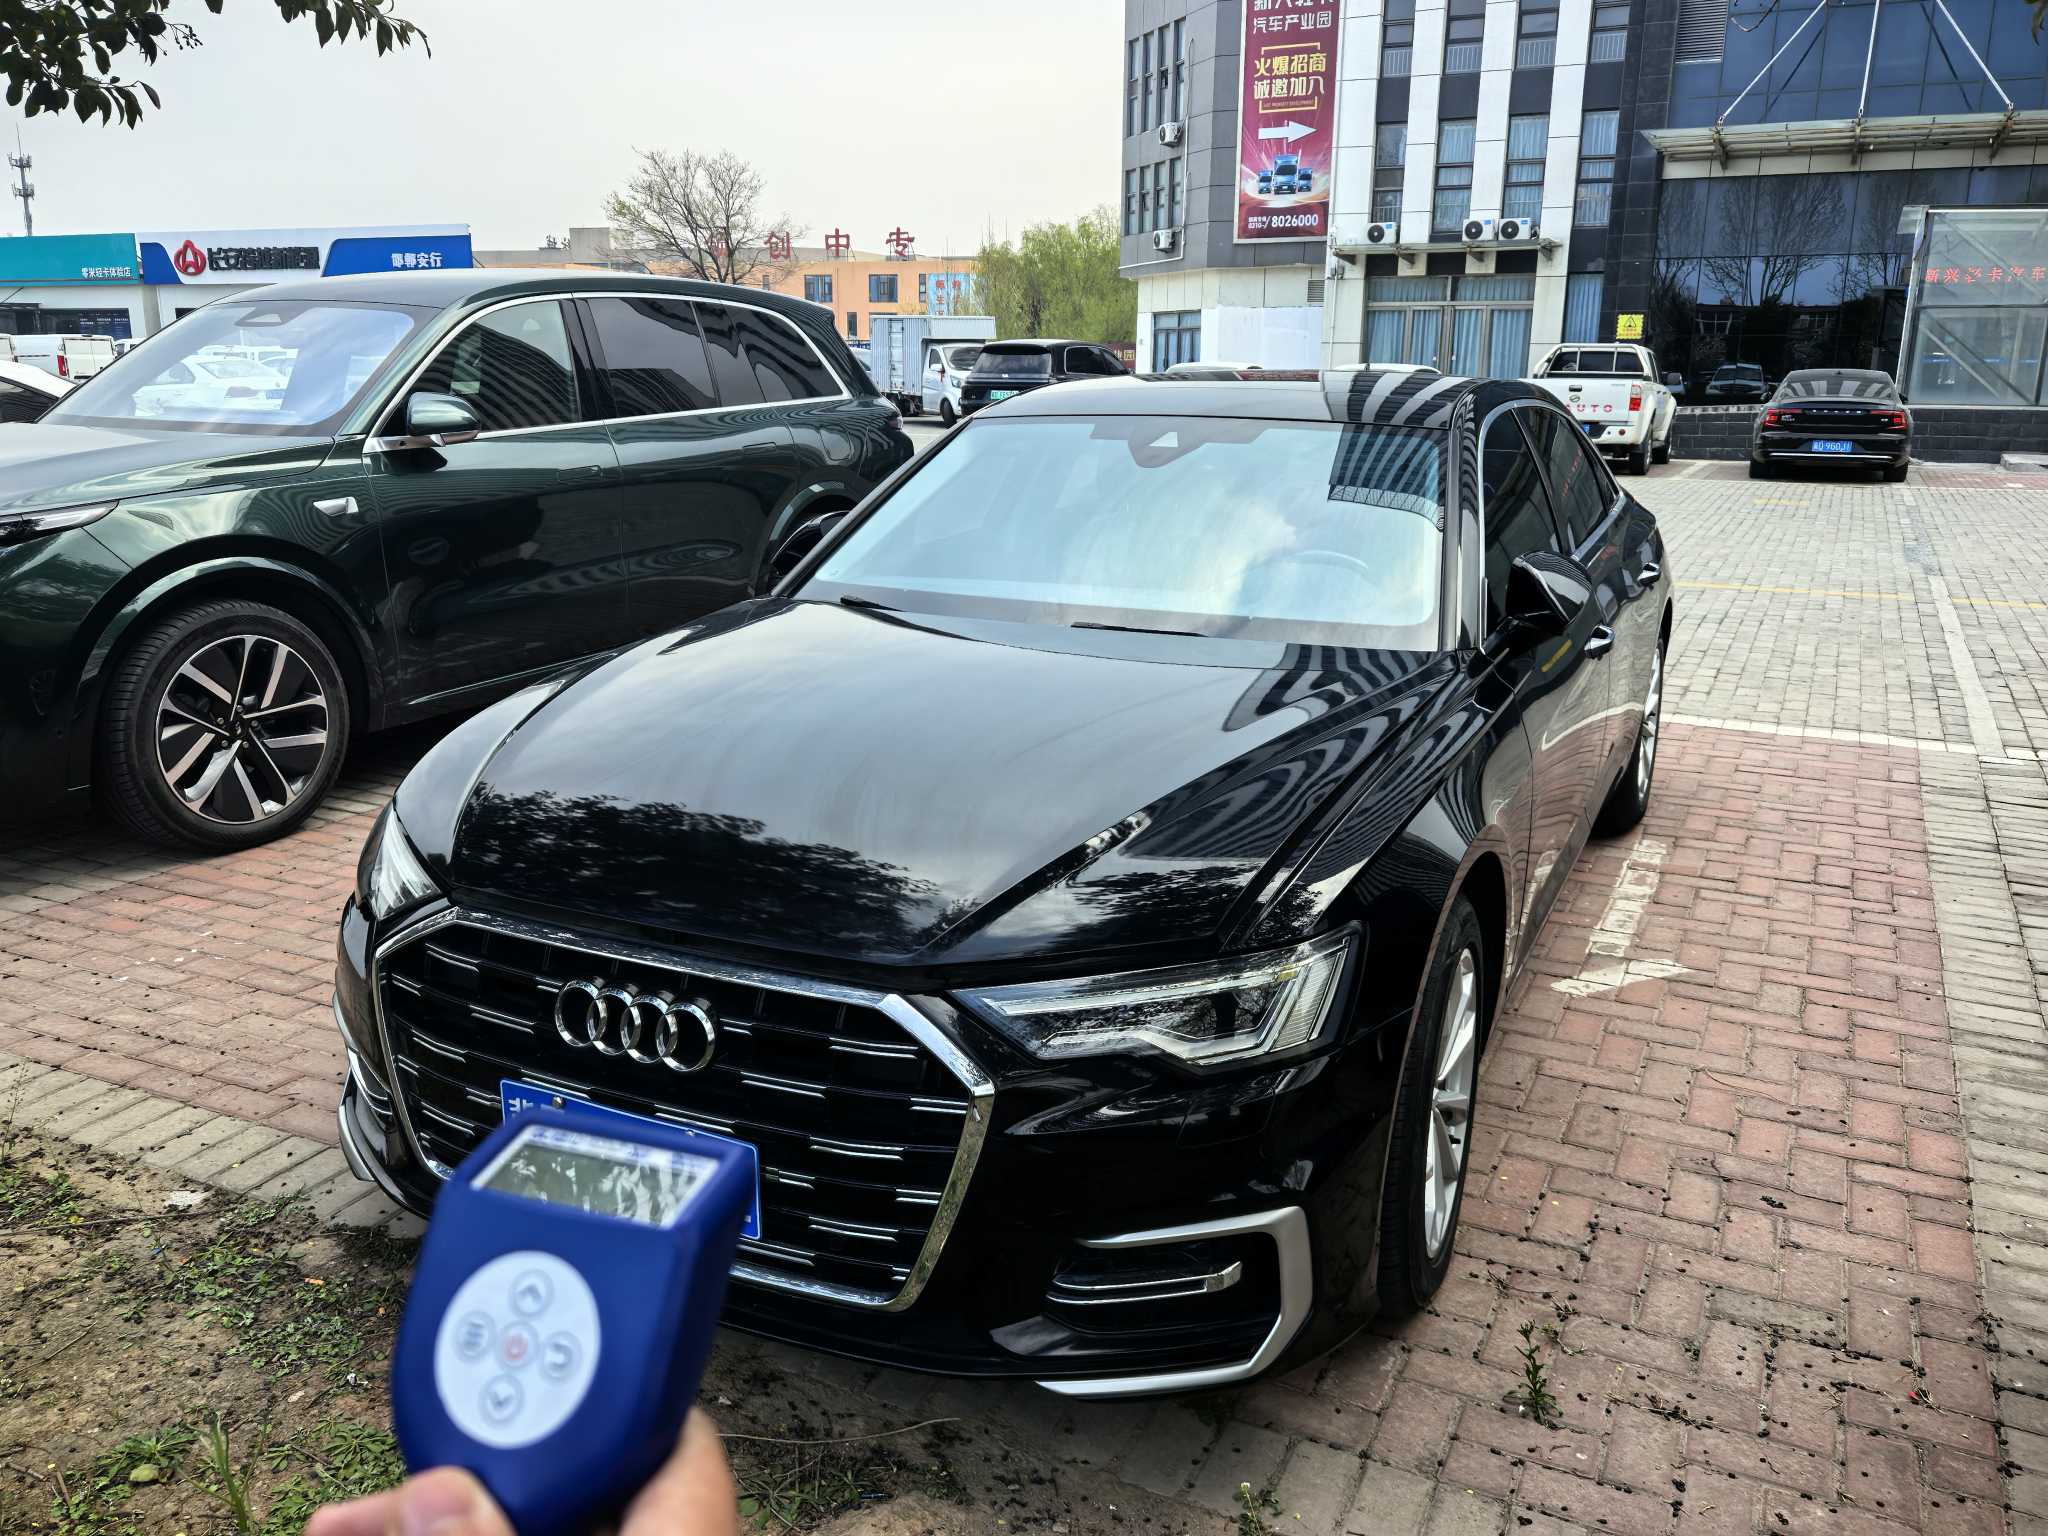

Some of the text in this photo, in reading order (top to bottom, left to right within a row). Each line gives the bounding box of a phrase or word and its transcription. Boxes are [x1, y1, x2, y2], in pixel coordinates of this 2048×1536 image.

[1253, 11, 1332, 34] 汽车产业园
[1254, 52, 1327, 77] 火爆招商
[1254, 76, 1325, 99] 诚邀加入
[1271, 214, 1319, 227] 8026000
[391, 252, 442, 268] 邯郸安行
